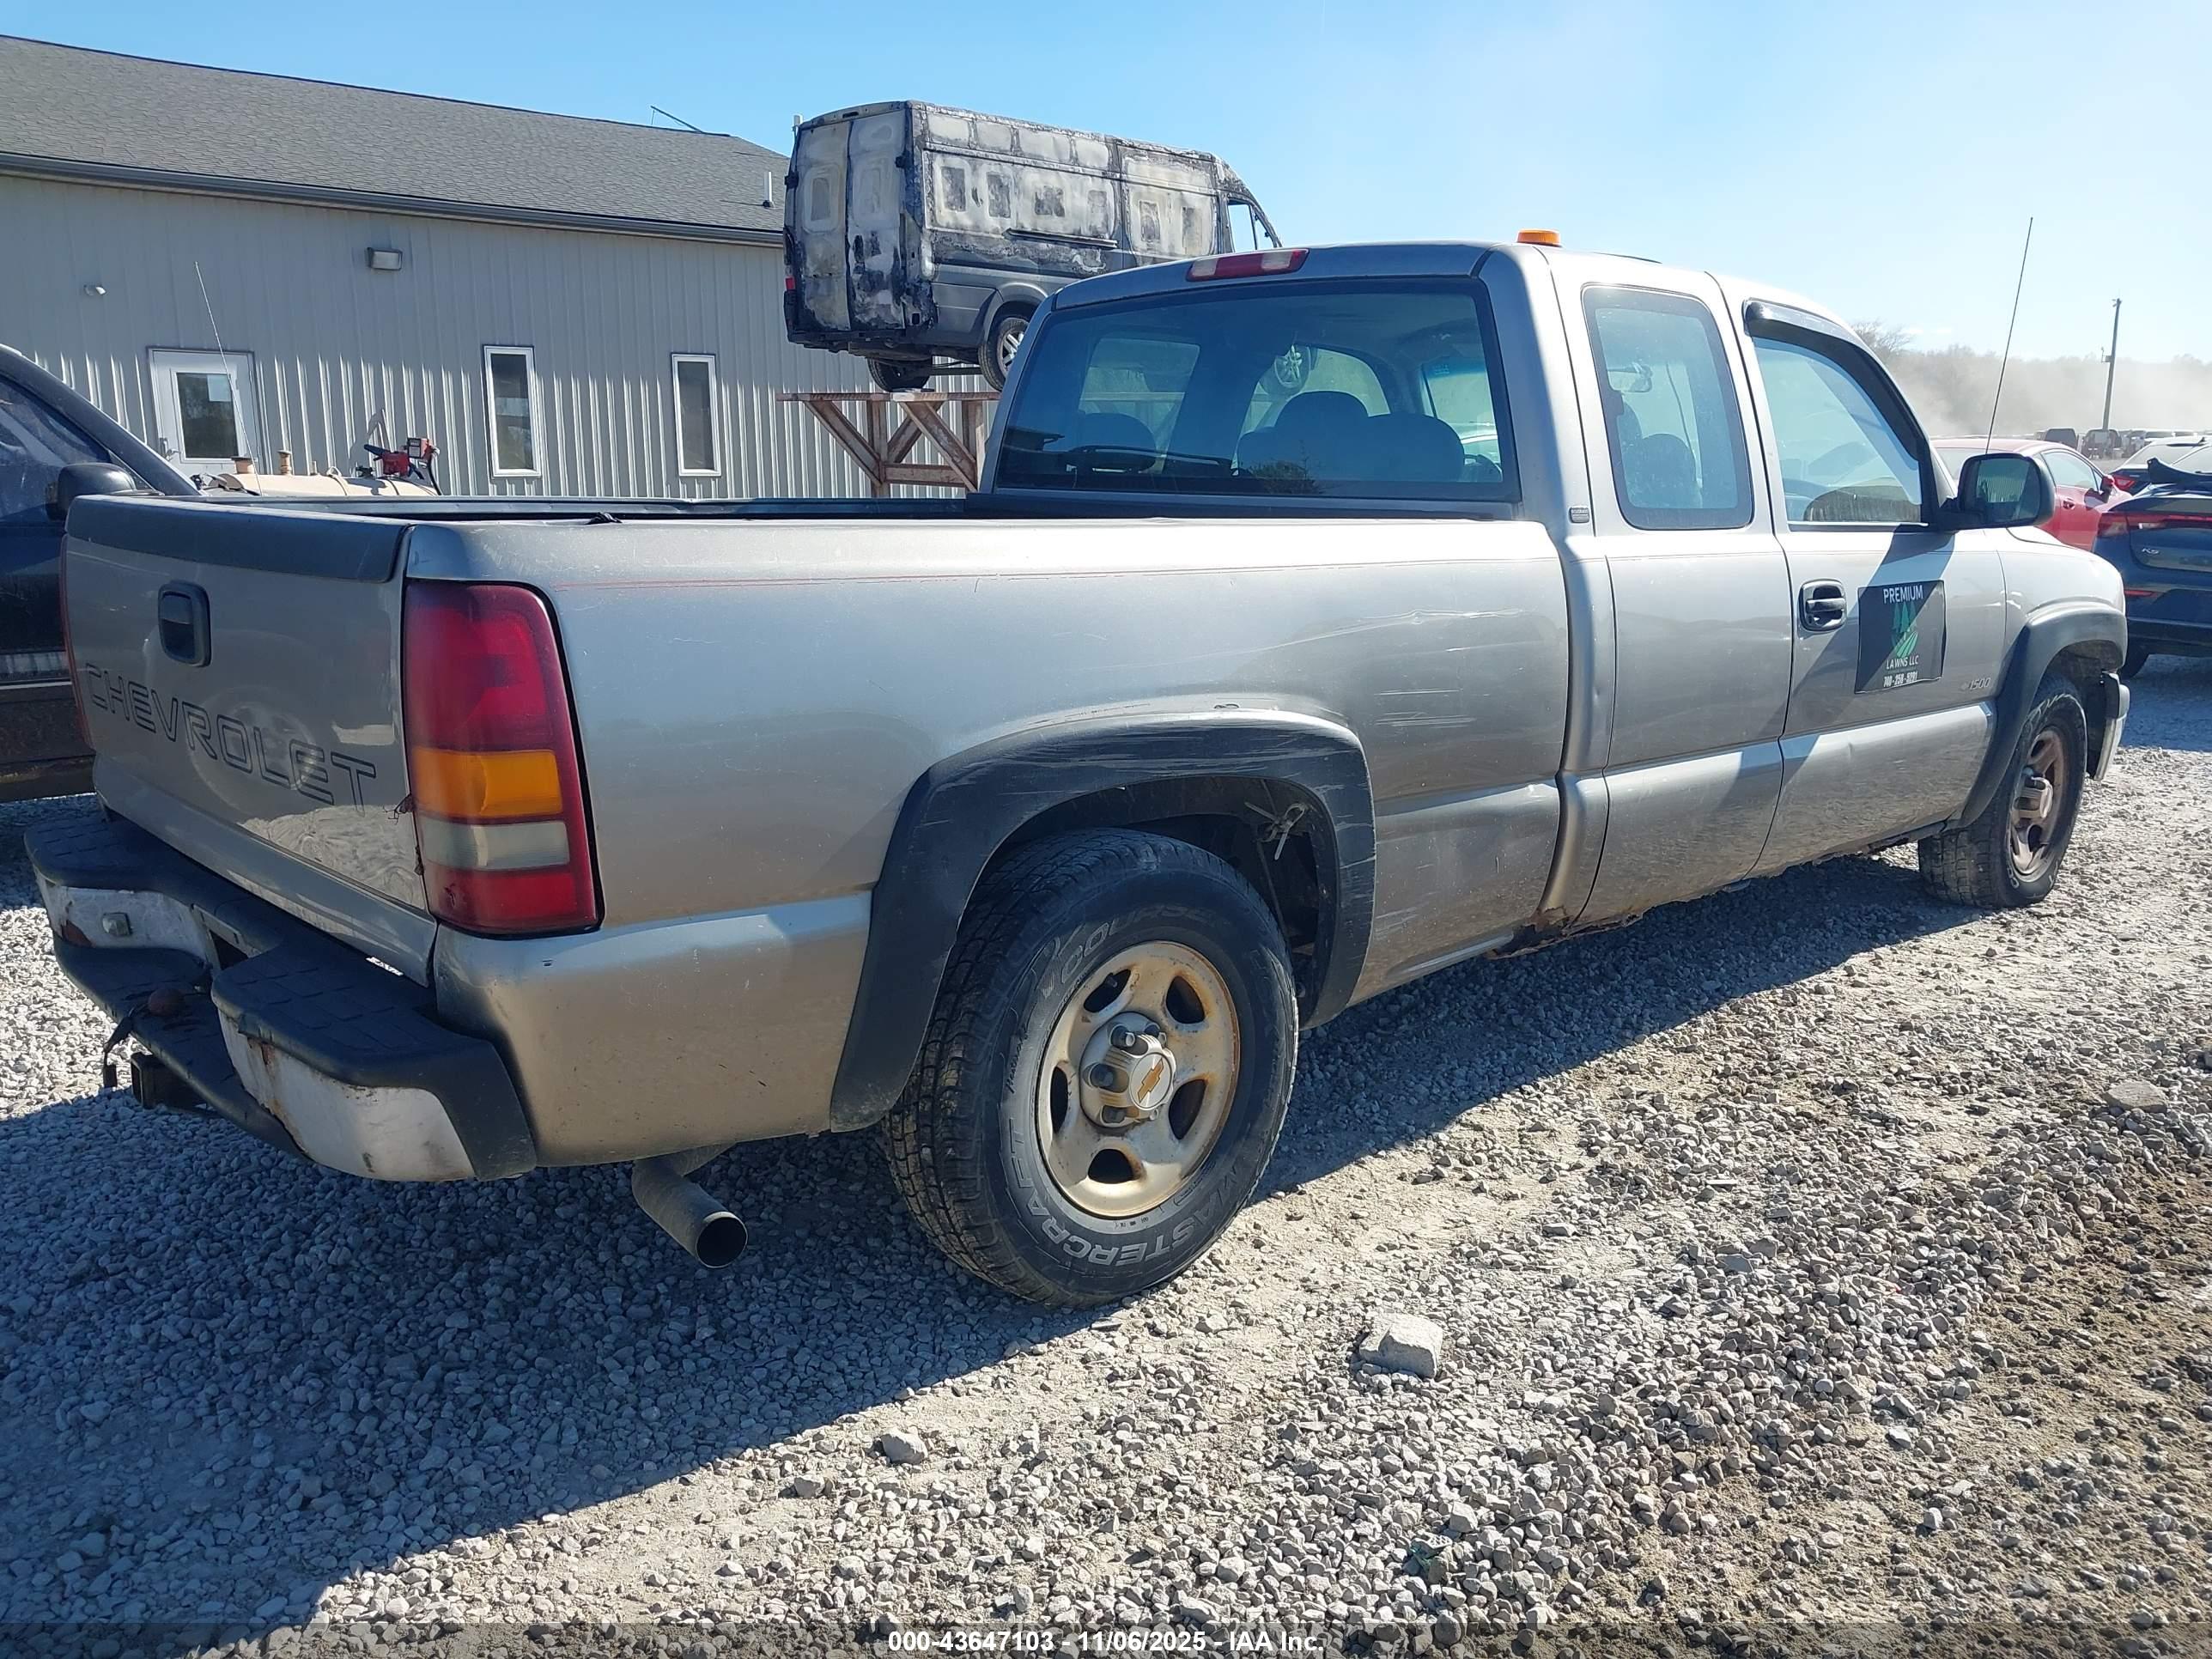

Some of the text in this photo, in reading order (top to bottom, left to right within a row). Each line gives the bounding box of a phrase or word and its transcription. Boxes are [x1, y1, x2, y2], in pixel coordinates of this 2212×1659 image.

[1883, 585, 1923, 605] PREMIUM
[1886, 654, 1919, 670] LAWNS LLC
[1970, 677, 1991, 690] 1500
[85, 663, 377, 817] CHEVROLET
